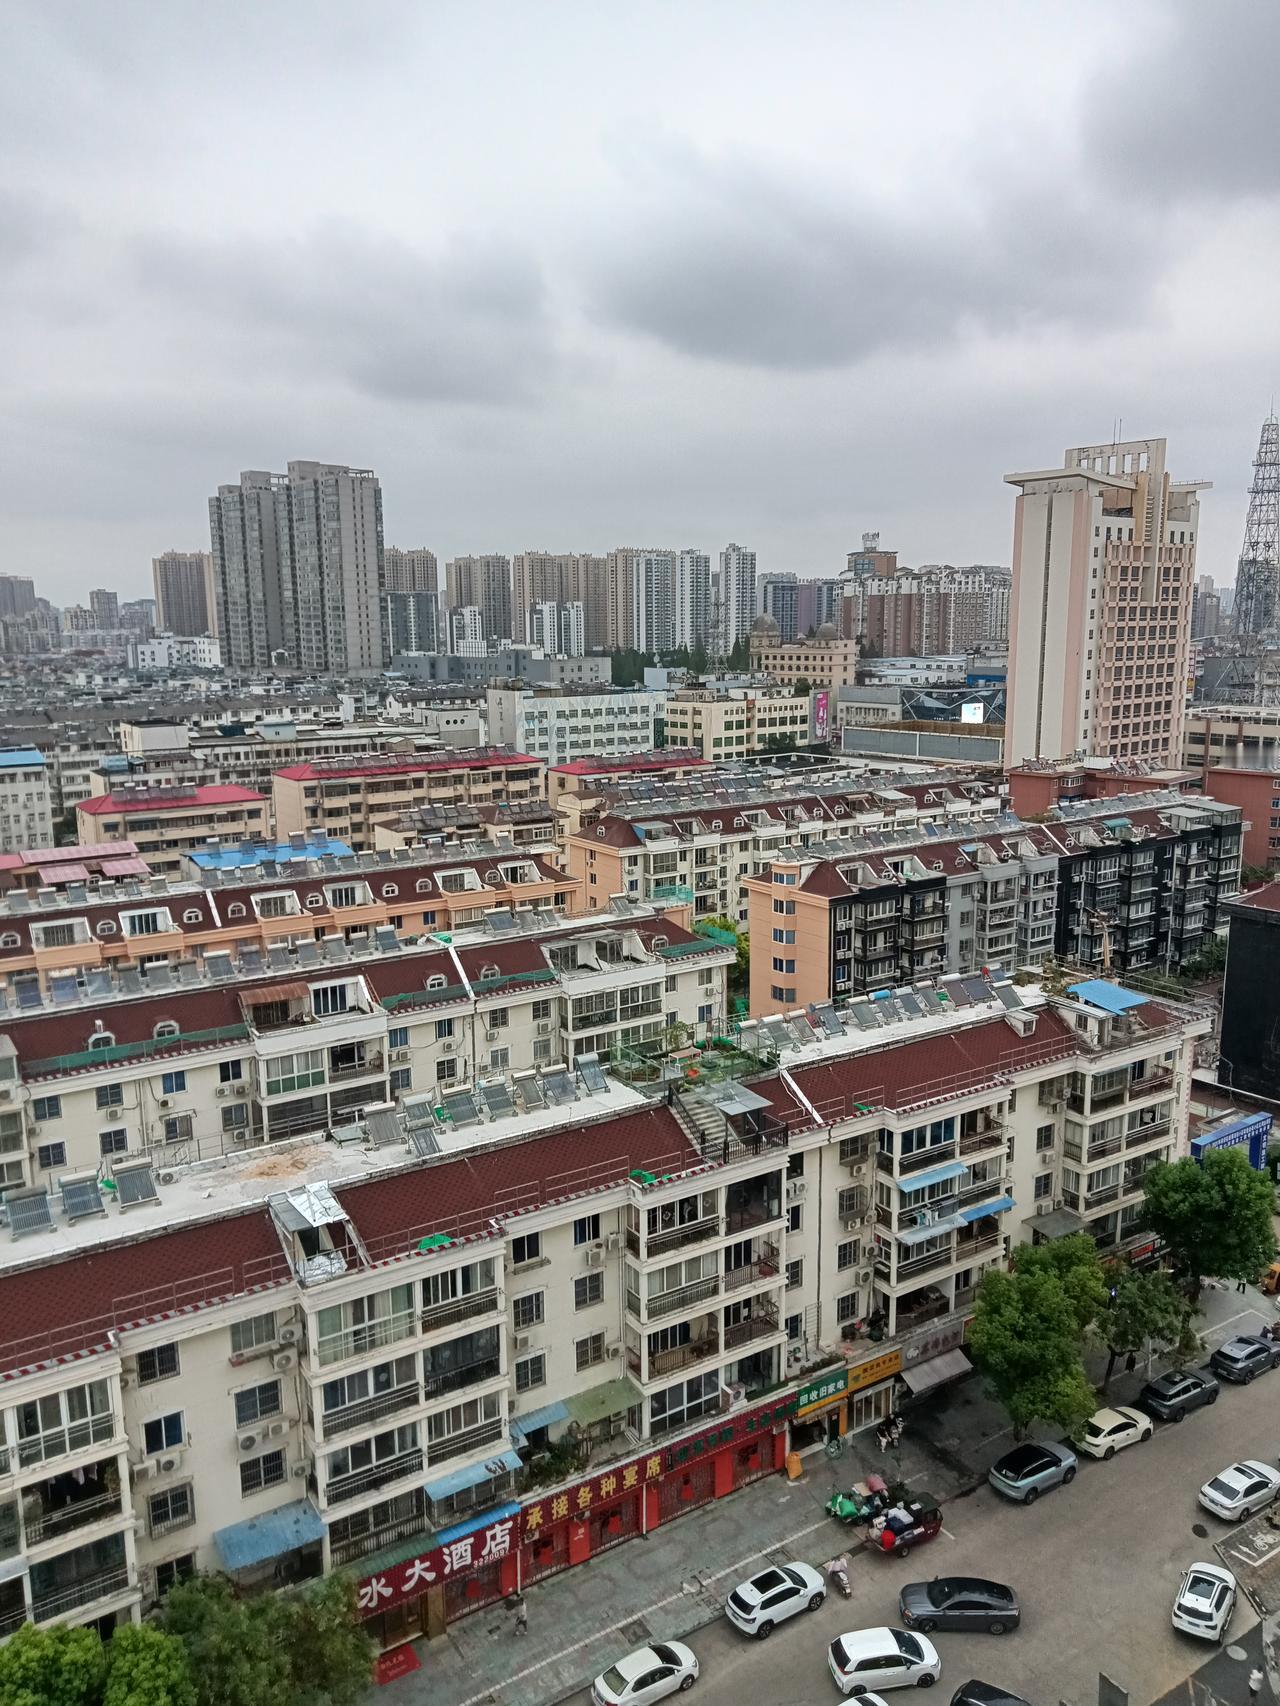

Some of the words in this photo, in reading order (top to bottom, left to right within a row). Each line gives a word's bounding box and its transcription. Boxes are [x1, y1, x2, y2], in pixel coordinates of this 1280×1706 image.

[526, 1456, 661, 1529] 承接各种宴席
